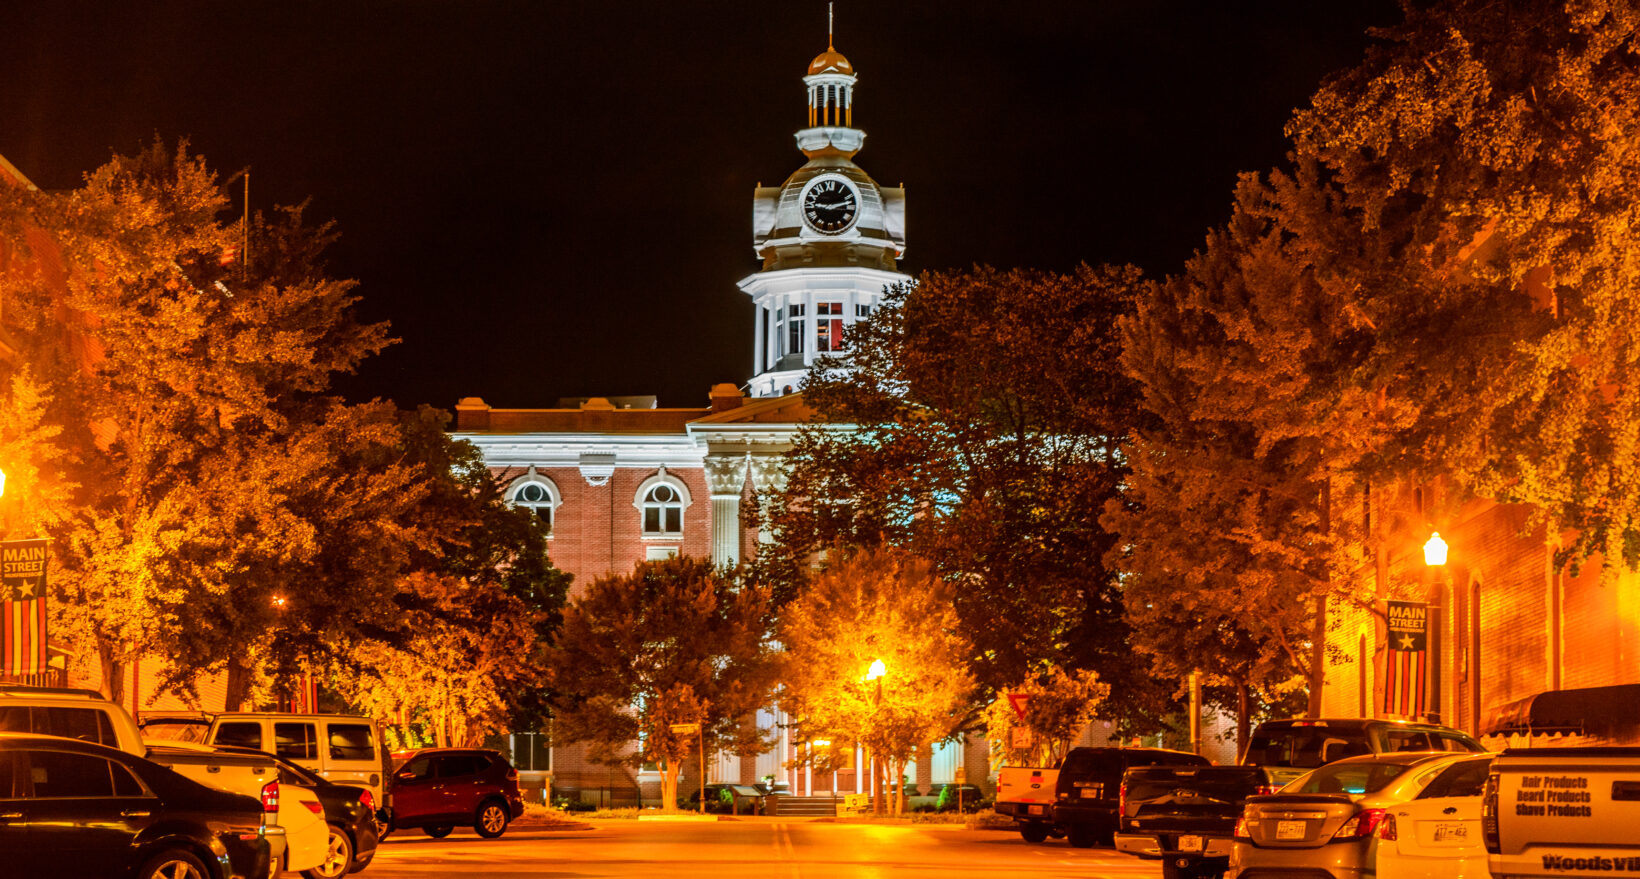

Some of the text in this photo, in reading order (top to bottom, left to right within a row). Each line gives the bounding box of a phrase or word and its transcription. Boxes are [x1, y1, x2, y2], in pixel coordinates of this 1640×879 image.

[4, 547, 44, 561] MAIN
[4, 560, 44, 572] STREET
[1389, 606, 1425, 618] MAIN
[1390, 617, 1425, 628] STREET
[1522, 776, 1588, 789] Hair Products
[1517, 790, 1591, 803] Beard Products
[1516, 803, 1592, 817] Shave Products
